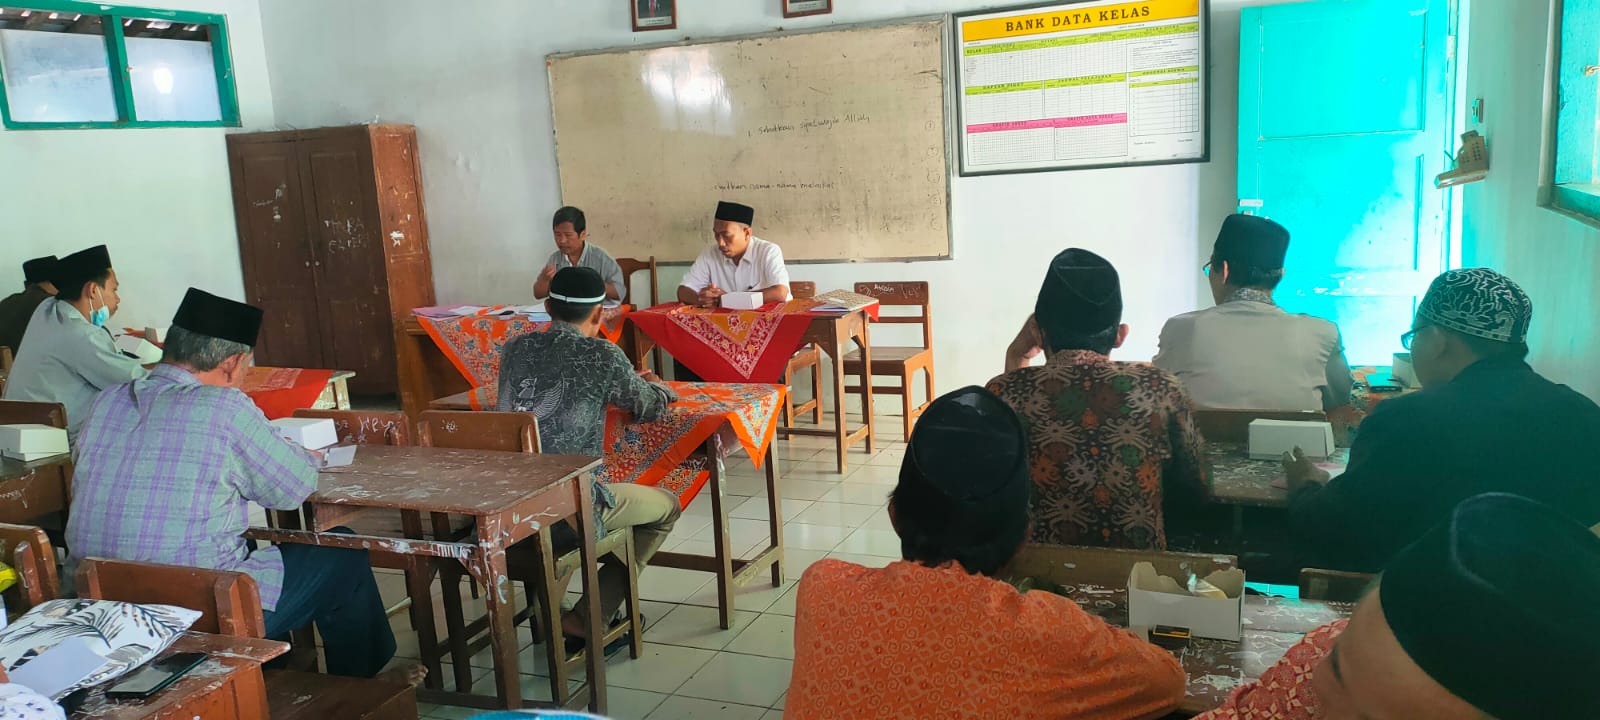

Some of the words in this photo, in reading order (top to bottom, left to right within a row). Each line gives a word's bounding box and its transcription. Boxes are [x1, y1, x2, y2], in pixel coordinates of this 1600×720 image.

[1005, 18, 1045, 32] BANK
[1052, 12, 1092, 27] DATA
[1099, 6, 1150, 21] KELAS
